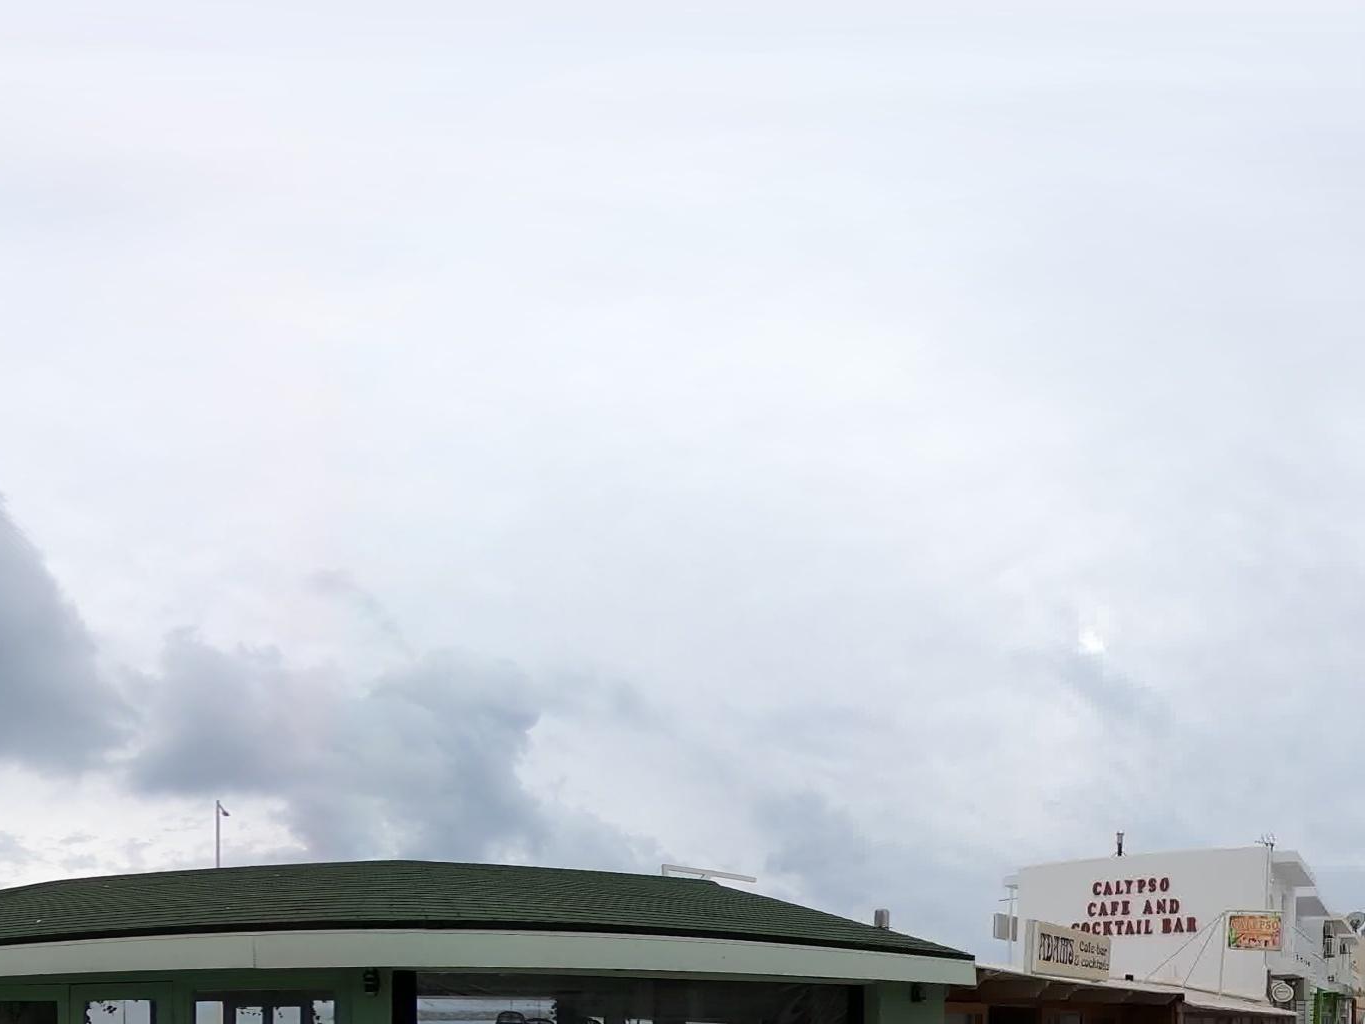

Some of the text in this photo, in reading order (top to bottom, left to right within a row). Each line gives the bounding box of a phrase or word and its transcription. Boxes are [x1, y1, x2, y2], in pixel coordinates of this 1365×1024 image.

[1092, 877, 1170, 895] CALYPSO
[1087, 899, 1180, 917] CAFE AND
[1162, 917, 1197, 934] BAR
[1039, 933, 1074, 965] ADAMS
